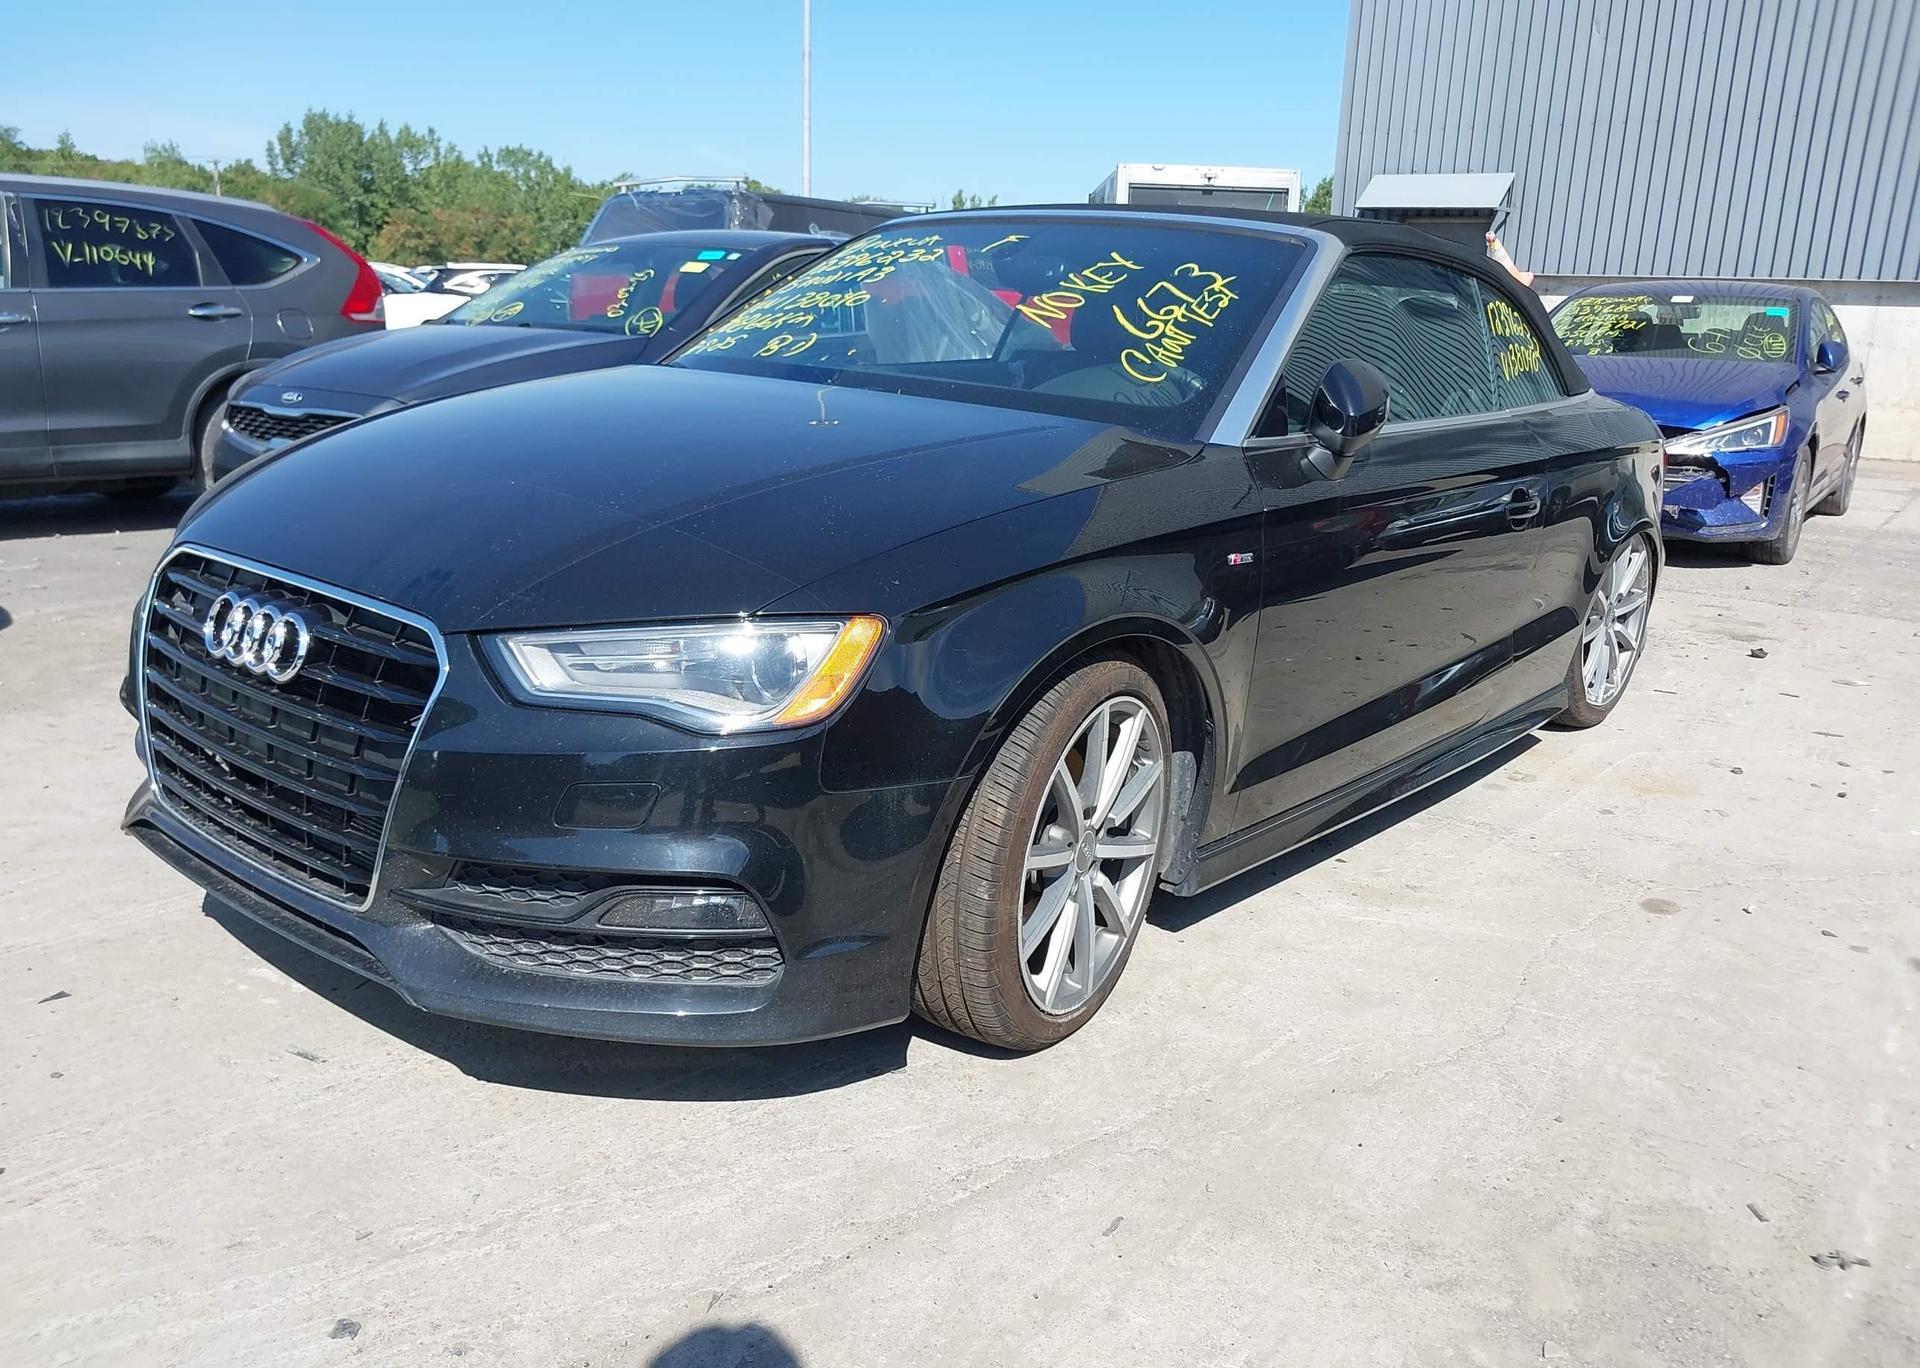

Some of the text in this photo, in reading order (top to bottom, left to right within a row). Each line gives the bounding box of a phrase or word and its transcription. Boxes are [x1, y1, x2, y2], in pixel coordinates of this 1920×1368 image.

[1016, 252, 1144, 329] NO KEY
[1112, 263, 1223, 340] 6673
